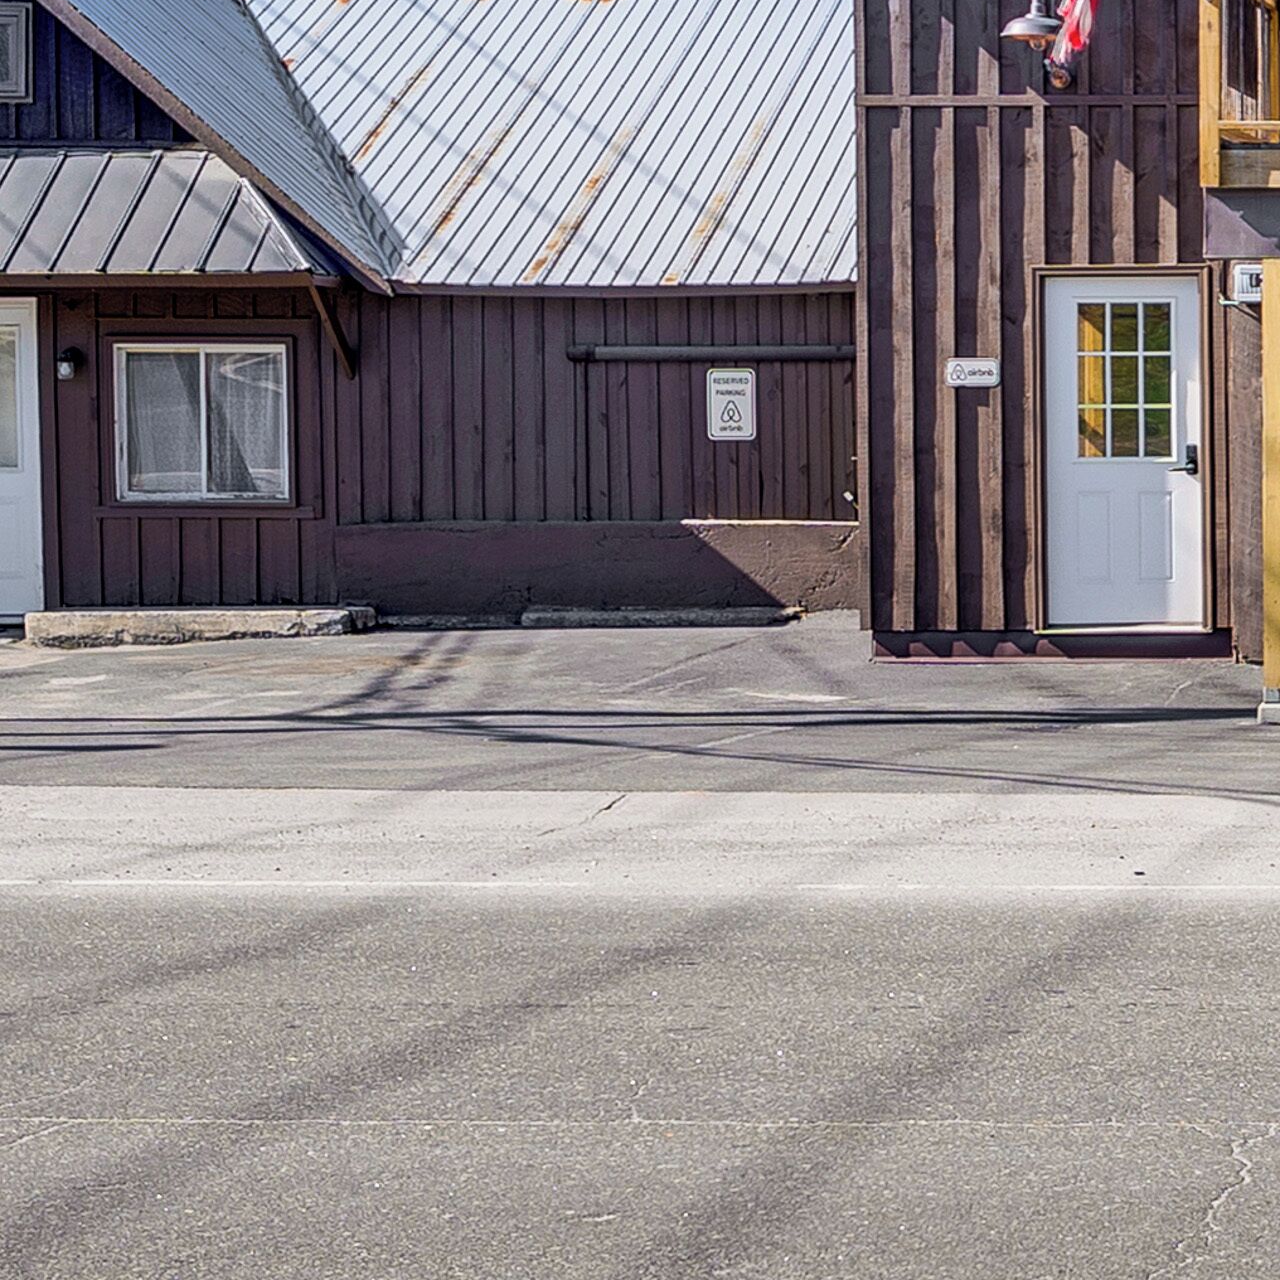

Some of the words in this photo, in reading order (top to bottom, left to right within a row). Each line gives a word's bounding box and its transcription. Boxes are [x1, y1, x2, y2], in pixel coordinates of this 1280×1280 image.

[967, 367, 995, 377] airbnb
[712, 377, 750, 385] RESERVED
[719, 424, 744, 432] airbnb
